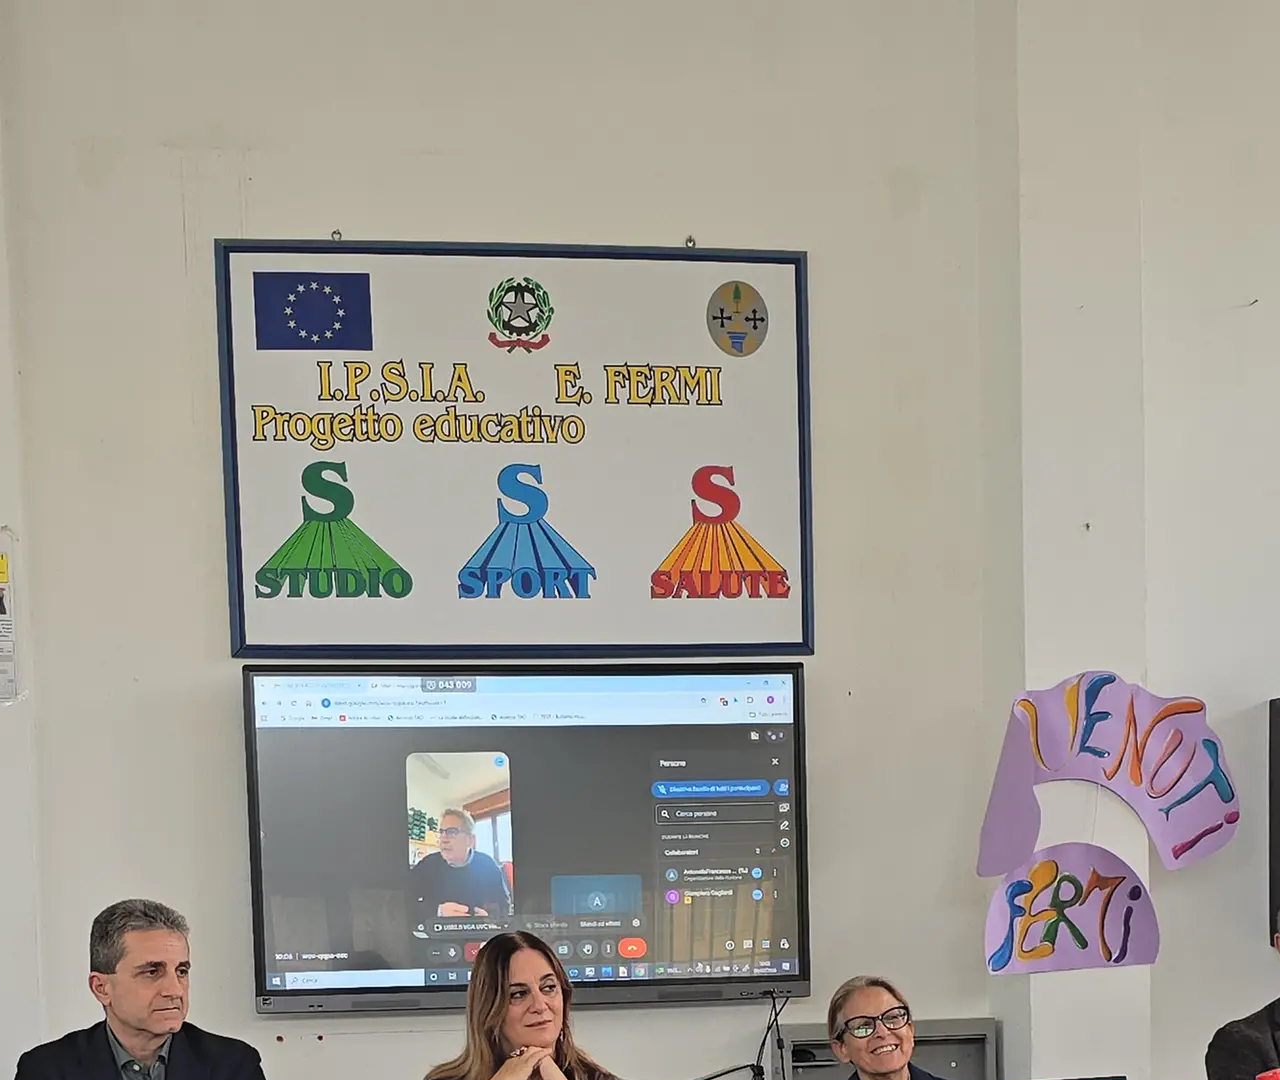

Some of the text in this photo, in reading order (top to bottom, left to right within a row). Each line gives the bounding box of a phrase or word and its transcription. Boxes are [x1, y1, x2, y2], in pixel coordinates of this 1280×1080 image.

[317, 360, 722, 406] I.P.S.I.A. E. FERMI
[252, 405, 585, 450] Progetto educativo
[301, 460, 740, 524] S S S
[255, 567, 791, 600] STUDIO SPORT SALUTE
[593, 896, 602, 906] A
